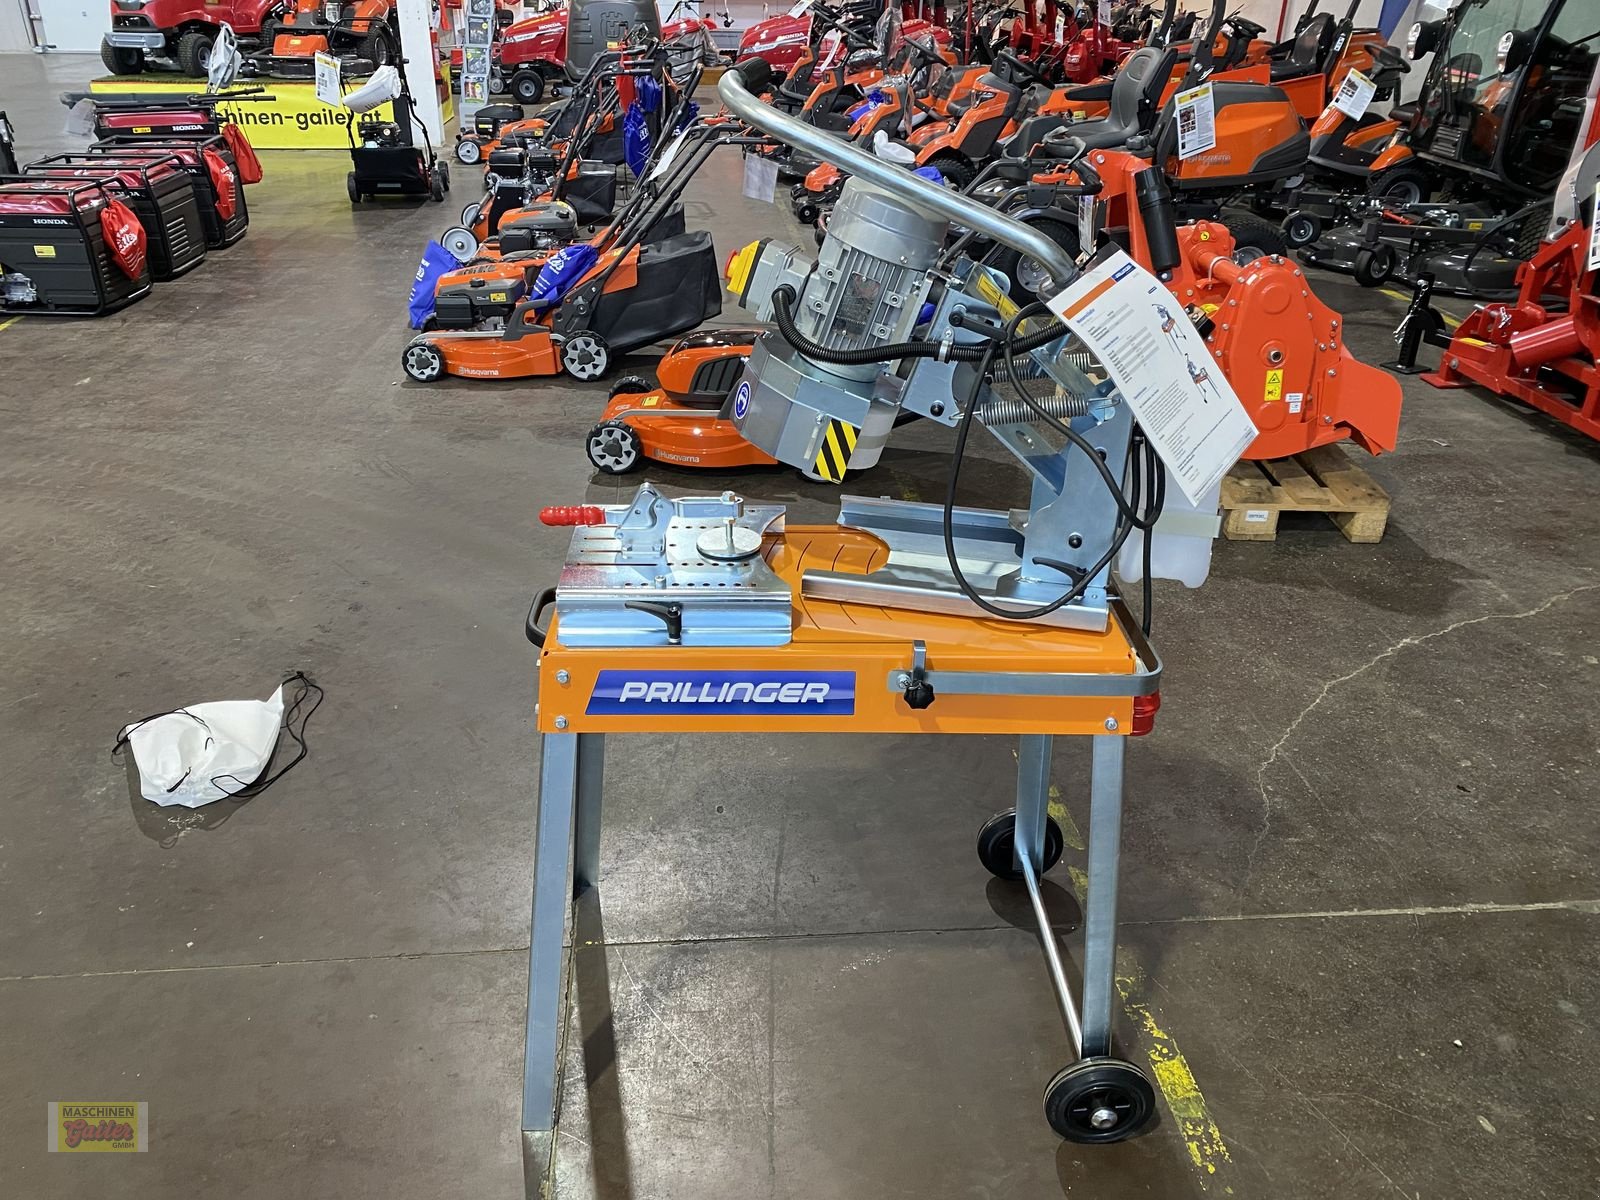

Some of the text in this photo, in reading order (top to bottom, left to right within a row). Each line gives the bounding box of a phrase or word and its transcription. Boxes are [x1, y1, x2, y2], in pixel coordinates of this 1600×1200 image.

[173, 124, 204, 132] HONDA
[464, 367, 499, 376] Husqvarna
[660, 451, 700, 463] Husqvarna
[619, 681, 830, 703] PRILLINGER
